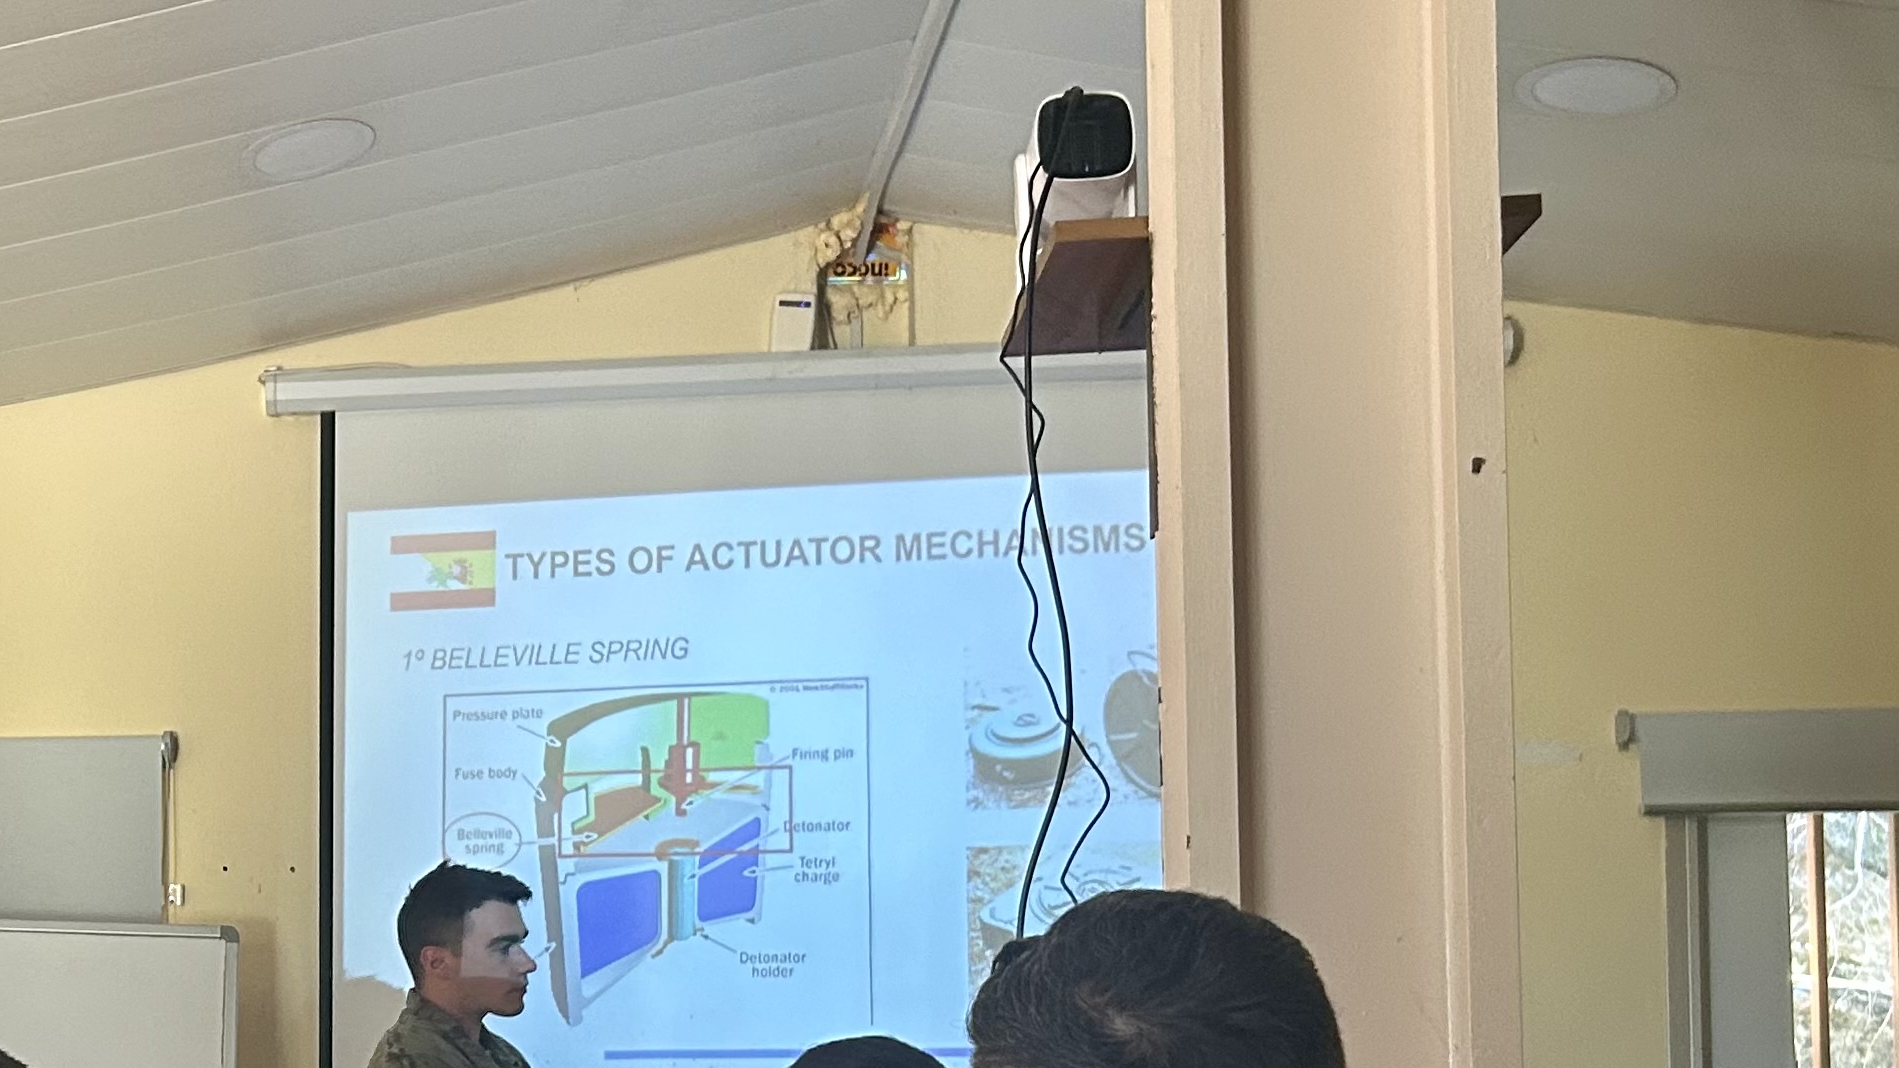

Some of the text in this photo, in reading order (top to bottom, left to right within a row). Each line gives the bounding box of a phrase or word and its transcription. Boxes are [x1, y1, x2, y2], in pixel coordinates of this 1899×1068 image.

[504, 522, 1148, 581] TYPES OF ACTUATOR MECHANISMS
[430, 642, 582, 671] BELLEVILLE
[588, 636, 690, 664] SPRING
[453, 707, 543, 722] Pressure plate
[791, 747, 855, 763] Firing pin
[454, 765, 518, 781] Fuse body
[783, 819, 851, 833] Detonator
[456, 828, 513, 841] Belleville
[464, 841, 505, 856] spring
[799, 856, 836, 872] Tetryl
[794, 868, 840, 884] charge
[740, 951, 806, 965] Detonator
[751, 965, 794, 979] holder
